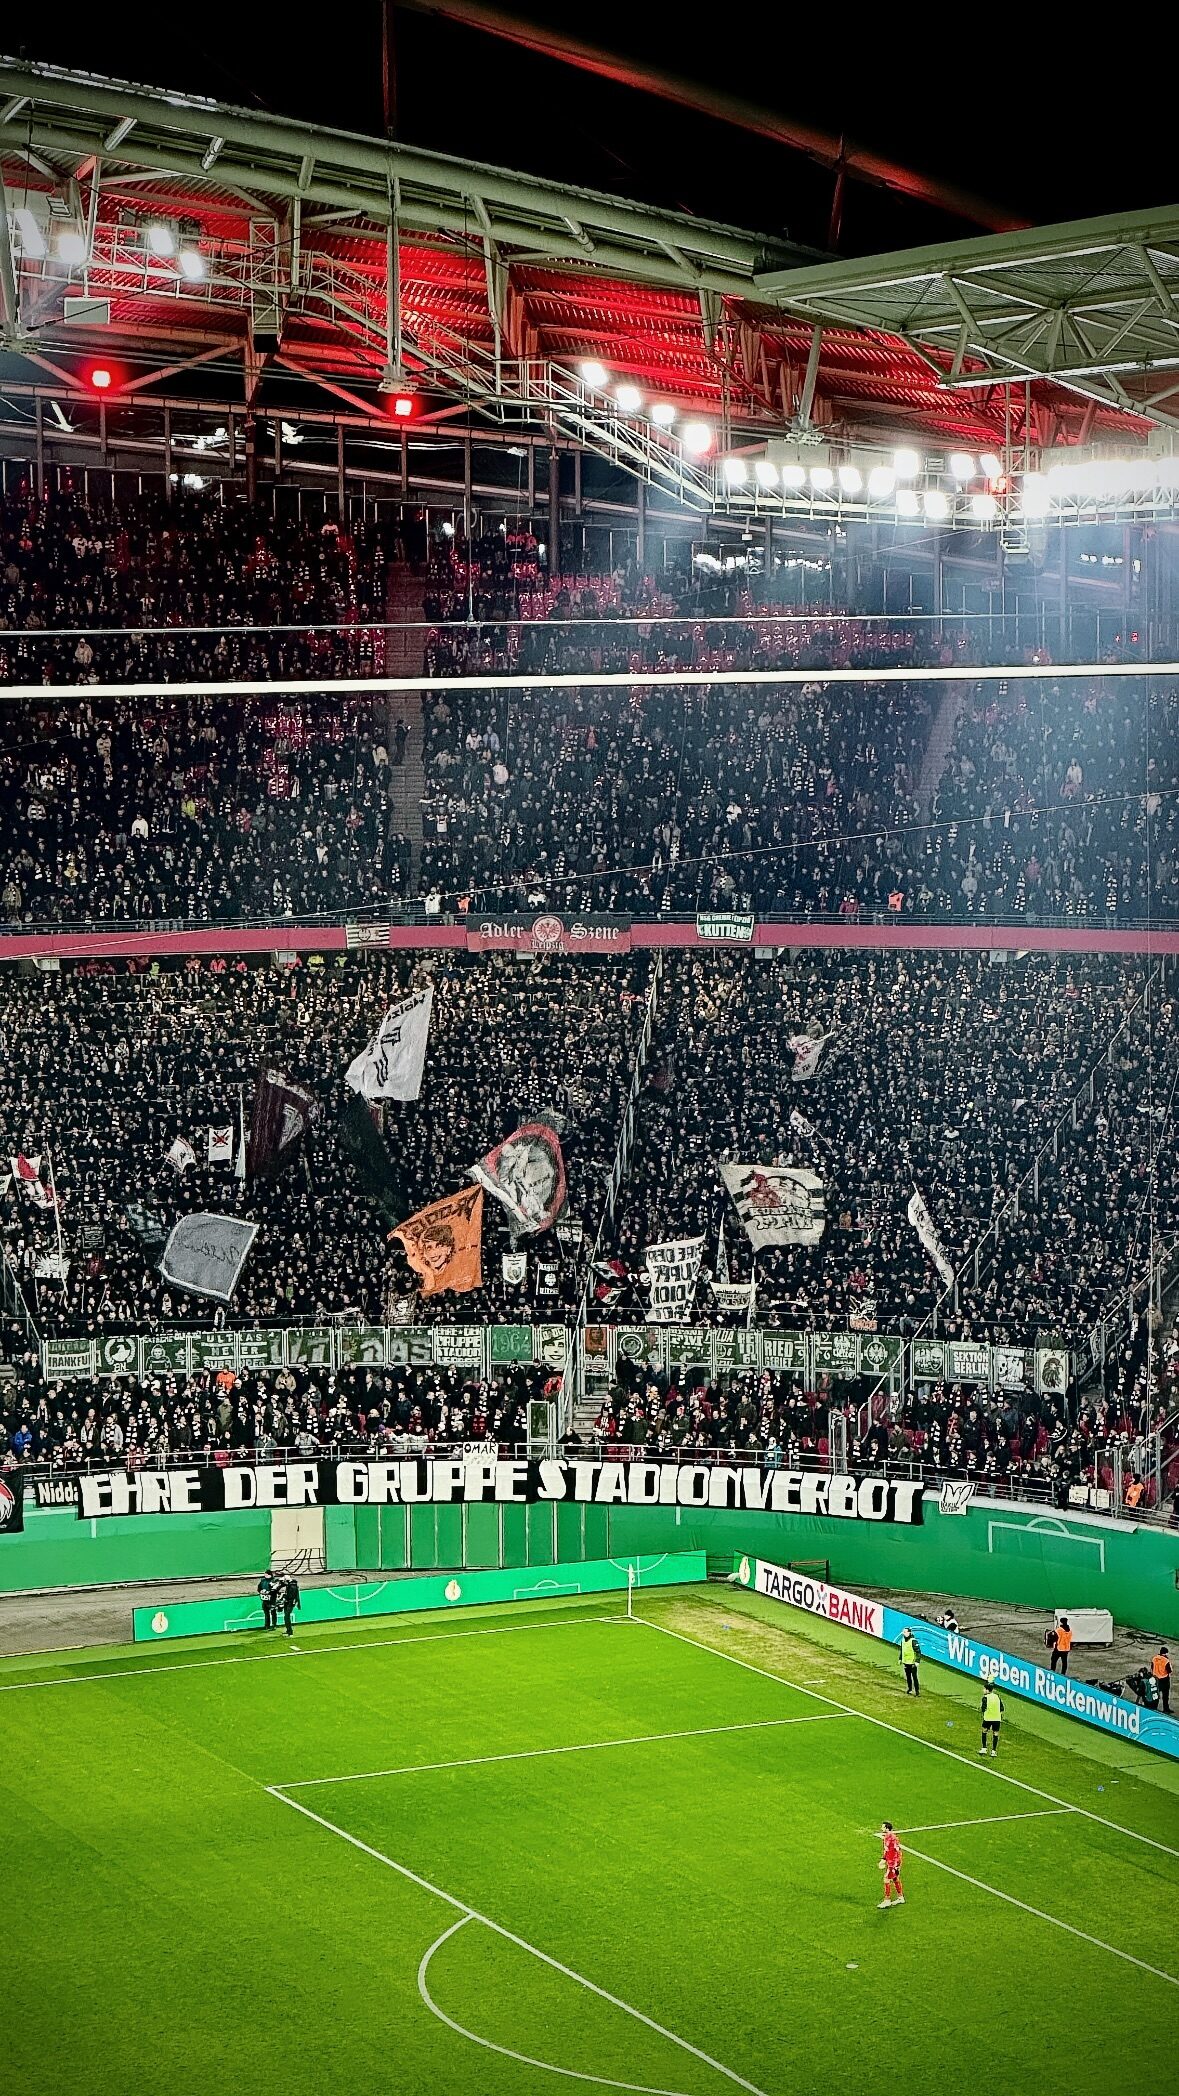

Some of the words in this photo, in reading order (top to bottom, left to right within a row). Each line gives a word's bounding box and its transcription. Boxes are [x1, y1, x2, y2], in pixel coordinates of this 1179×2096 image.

[480, 922, 524, 939] Adler
[570, 922, 619, 940] Szene
[703, 924, 744, 939] KUTTEN
[531, 938, 565, 950] Leipzig
[764, 1340, 794, 1358] RIED
[954, 1351, 989, 1363] SEKTION
[954, 1362, 989, 1375] BERLIN
[464, 1442, 496, 1454] OMAR
[79, 1470, 201, 1517] EHRE
[223, 1463, 319, 1507] DER
[336, 1460, 528, 1504] GRUPPE
[537, 1459, 923, 1523] STADIONVERBOT
[947, 1633, 976, 1668] Wir
[979, 1654, 1030, 1691] geben
[1034, 1667, 1140, 1735] Rückenwind
